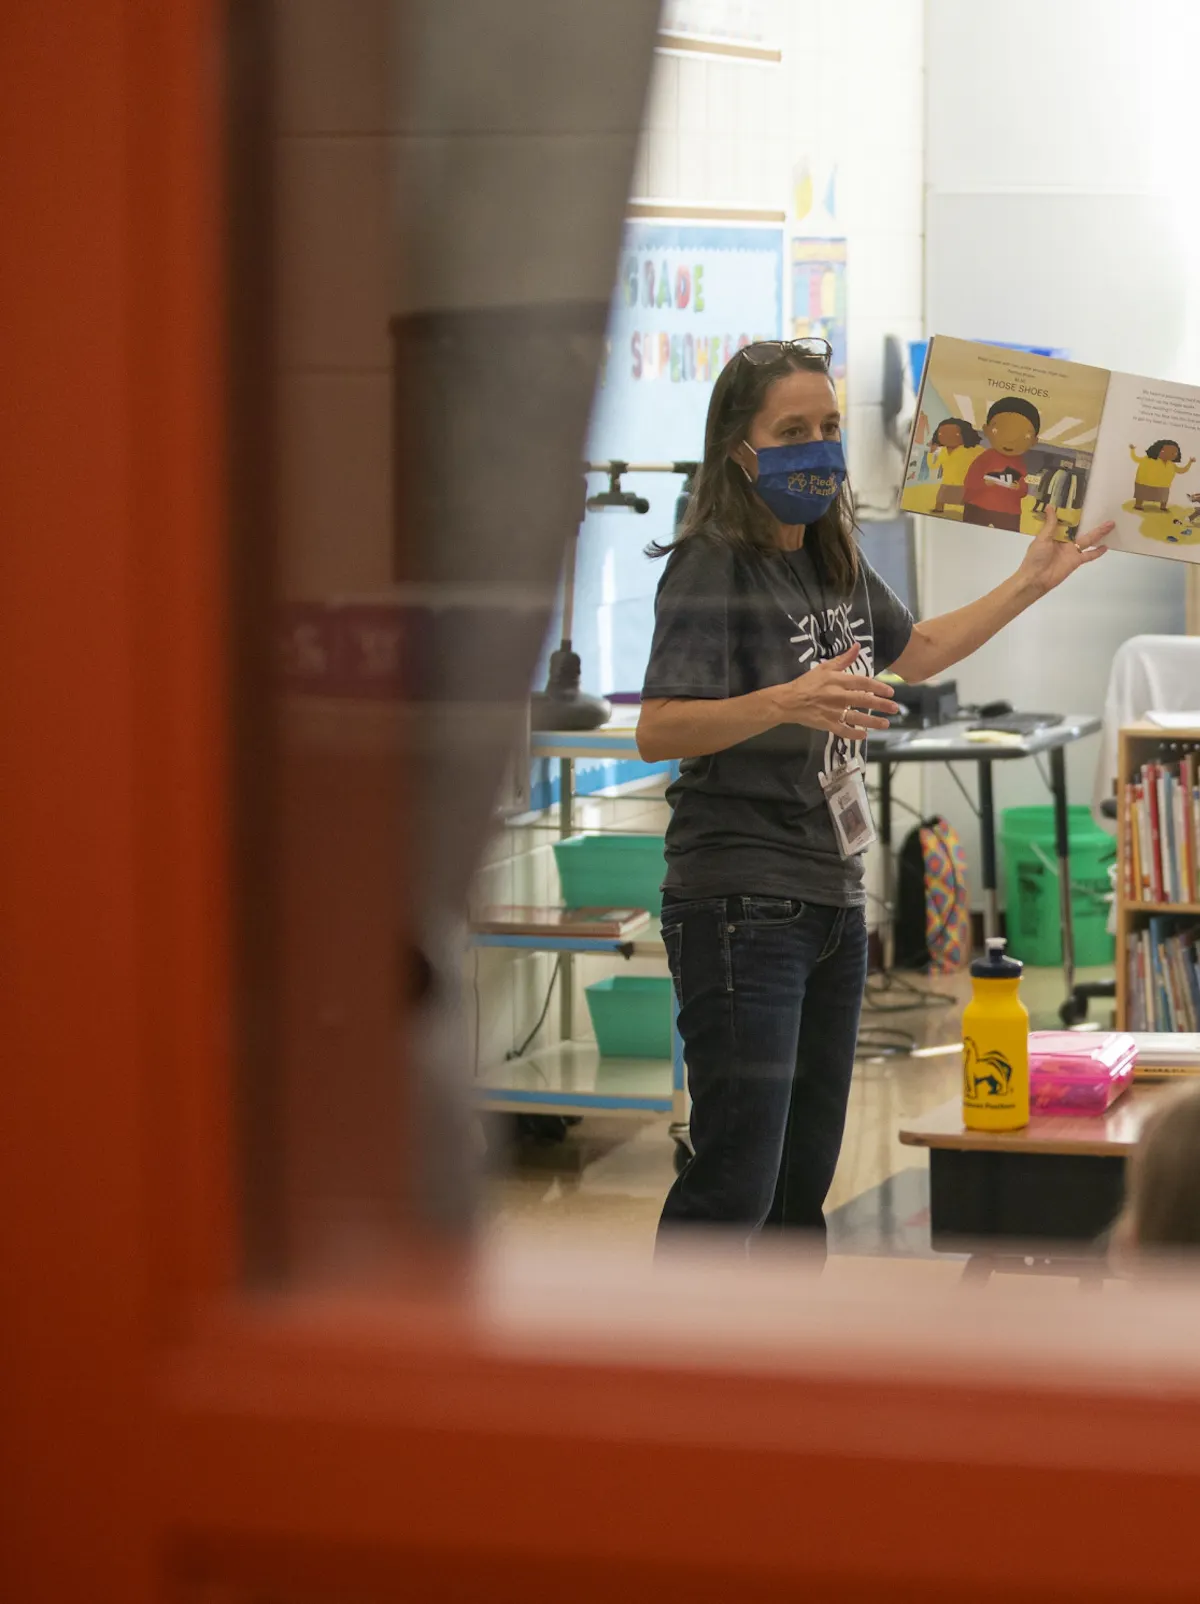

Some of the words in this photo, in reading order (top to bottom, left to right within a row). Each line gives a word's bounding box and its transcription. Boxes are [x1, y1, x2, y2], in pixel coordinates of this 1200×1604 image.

[624, 256, 704, 313] GRADE
[987, 378, 1017, 392] THOSE
[1018, 384, 1051, 399] SHOES.
